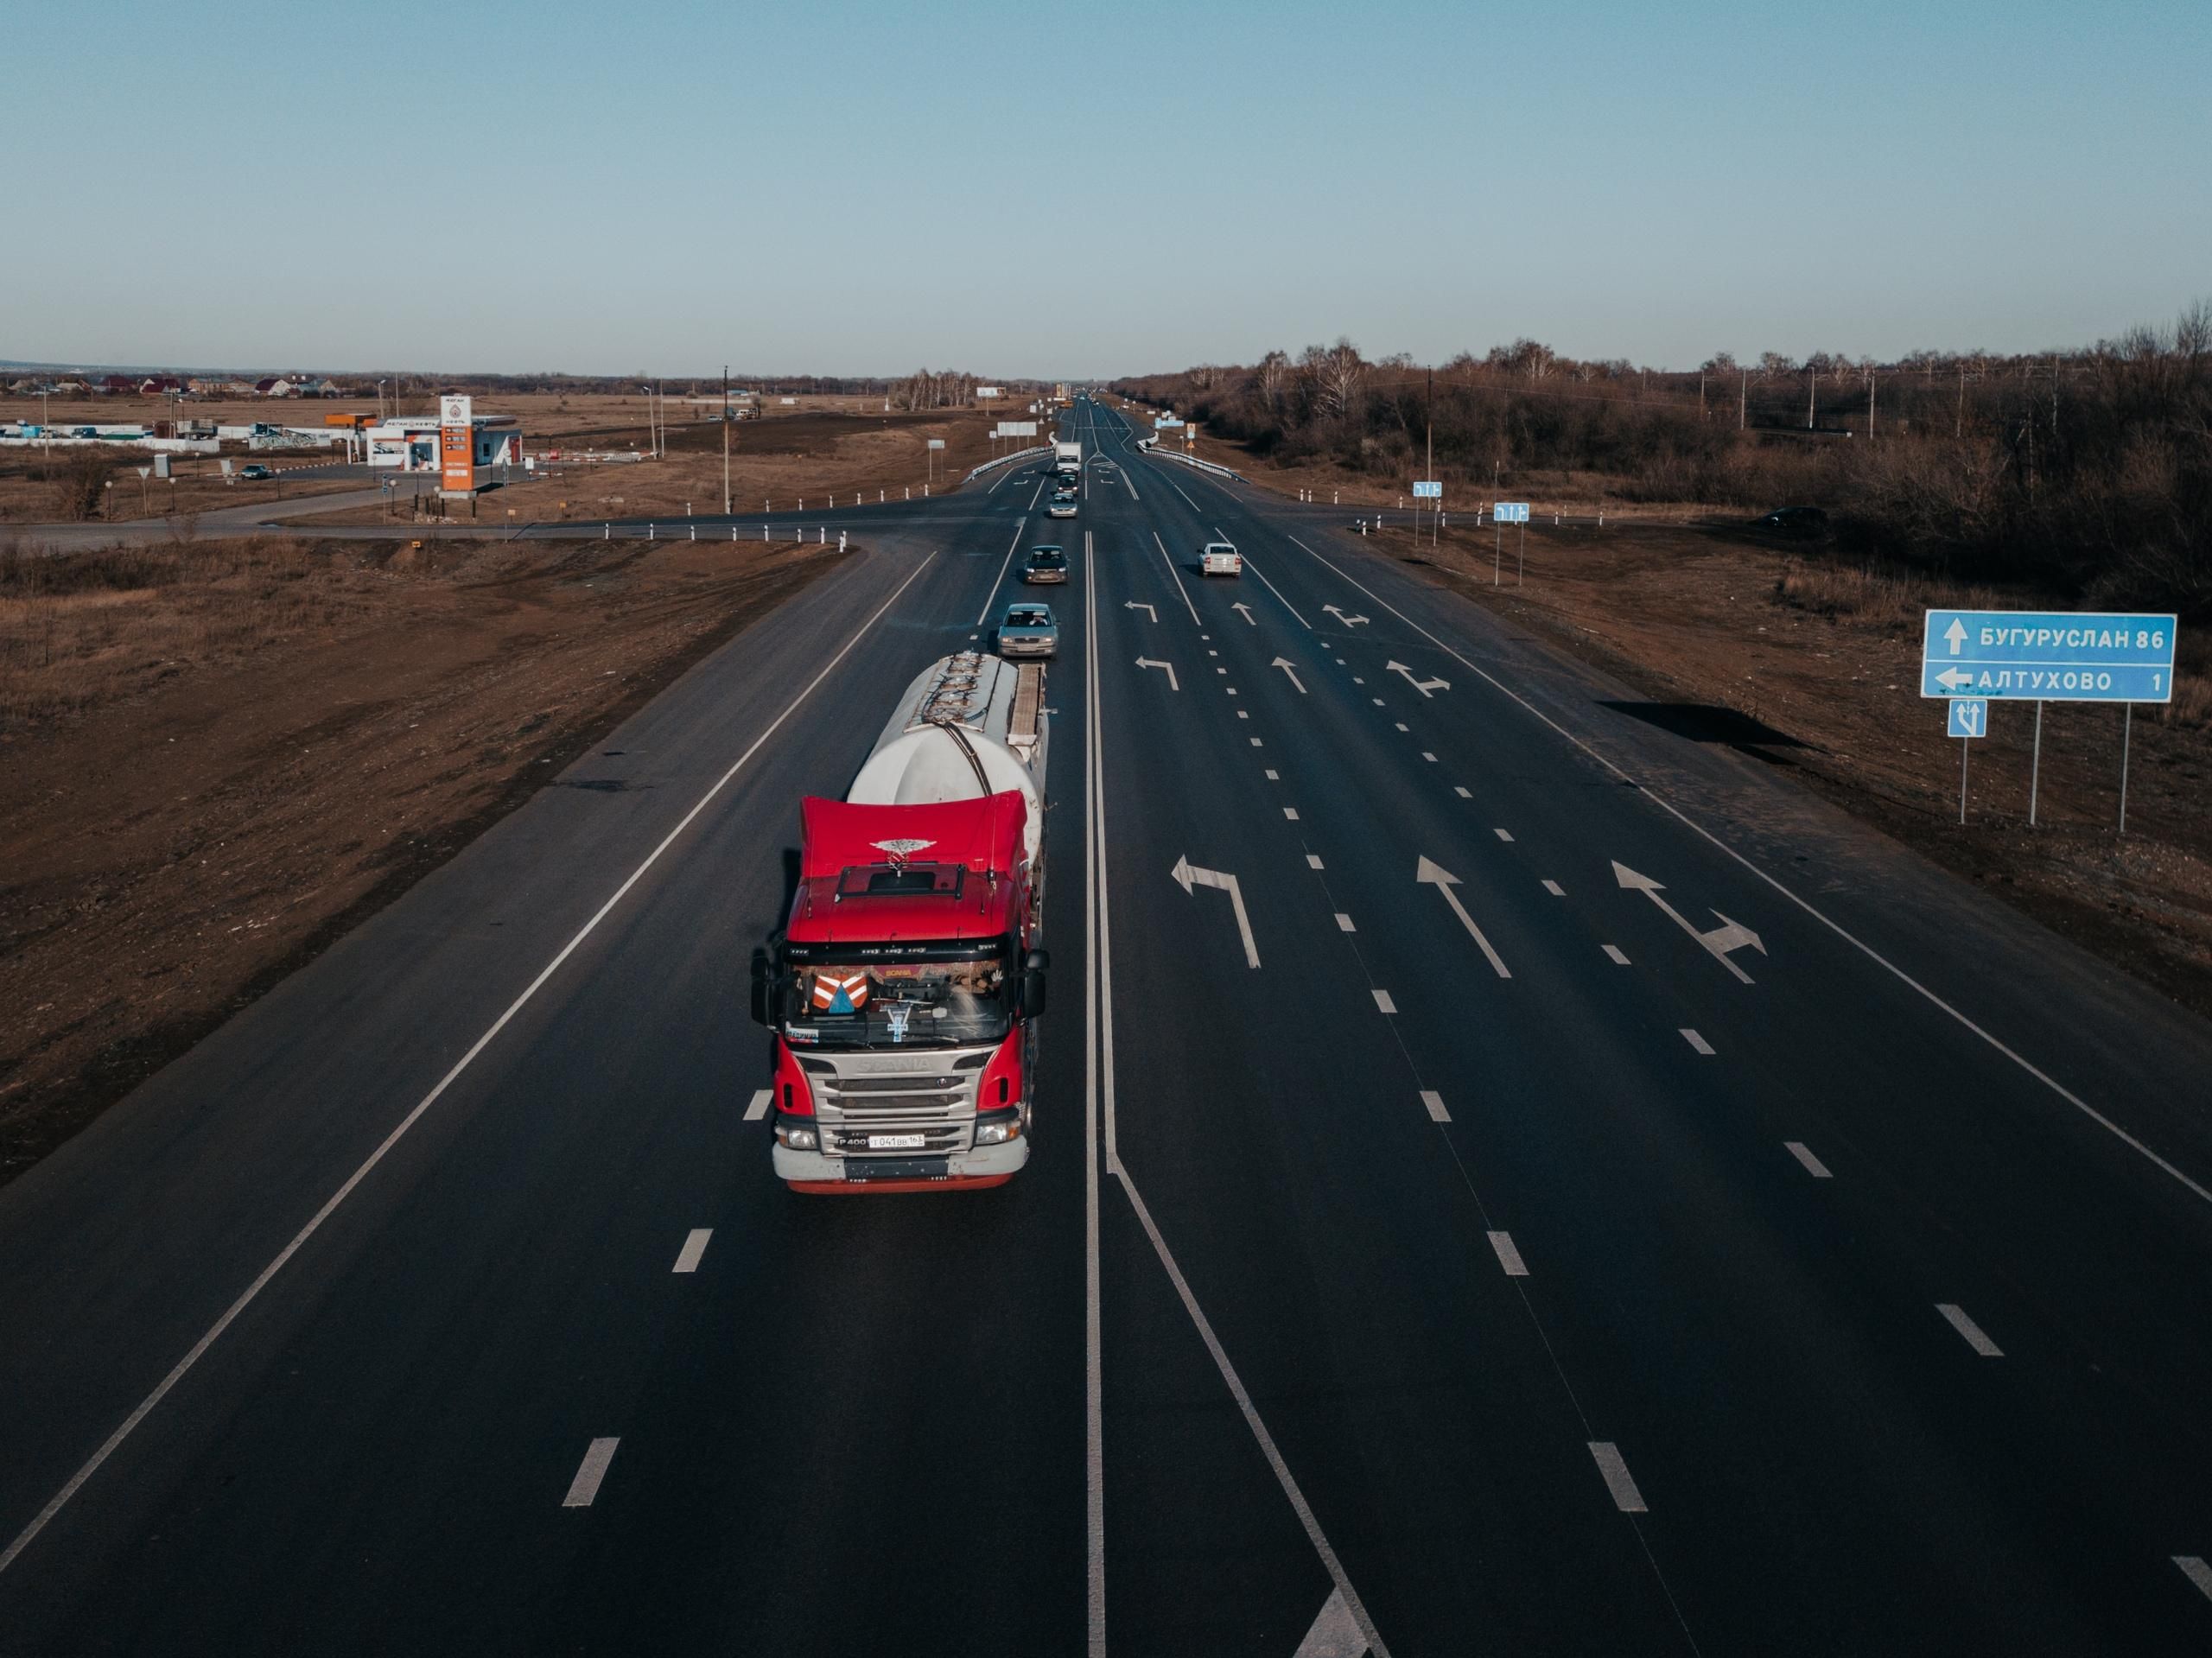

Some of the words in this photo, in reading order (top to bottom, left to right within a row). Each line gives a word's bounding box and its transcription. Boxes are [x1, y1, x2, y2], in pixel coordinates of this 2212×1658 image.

[1980, 627, 2130, 648] БУГУРУСЛАН
[2136, 631, 2164, 649] 86
[1978, 670, 2112, 691] АЛТУХОВО
[2152, 673, 2161, 692] 1
[857, 1058, 934, 1072] SCANIA
